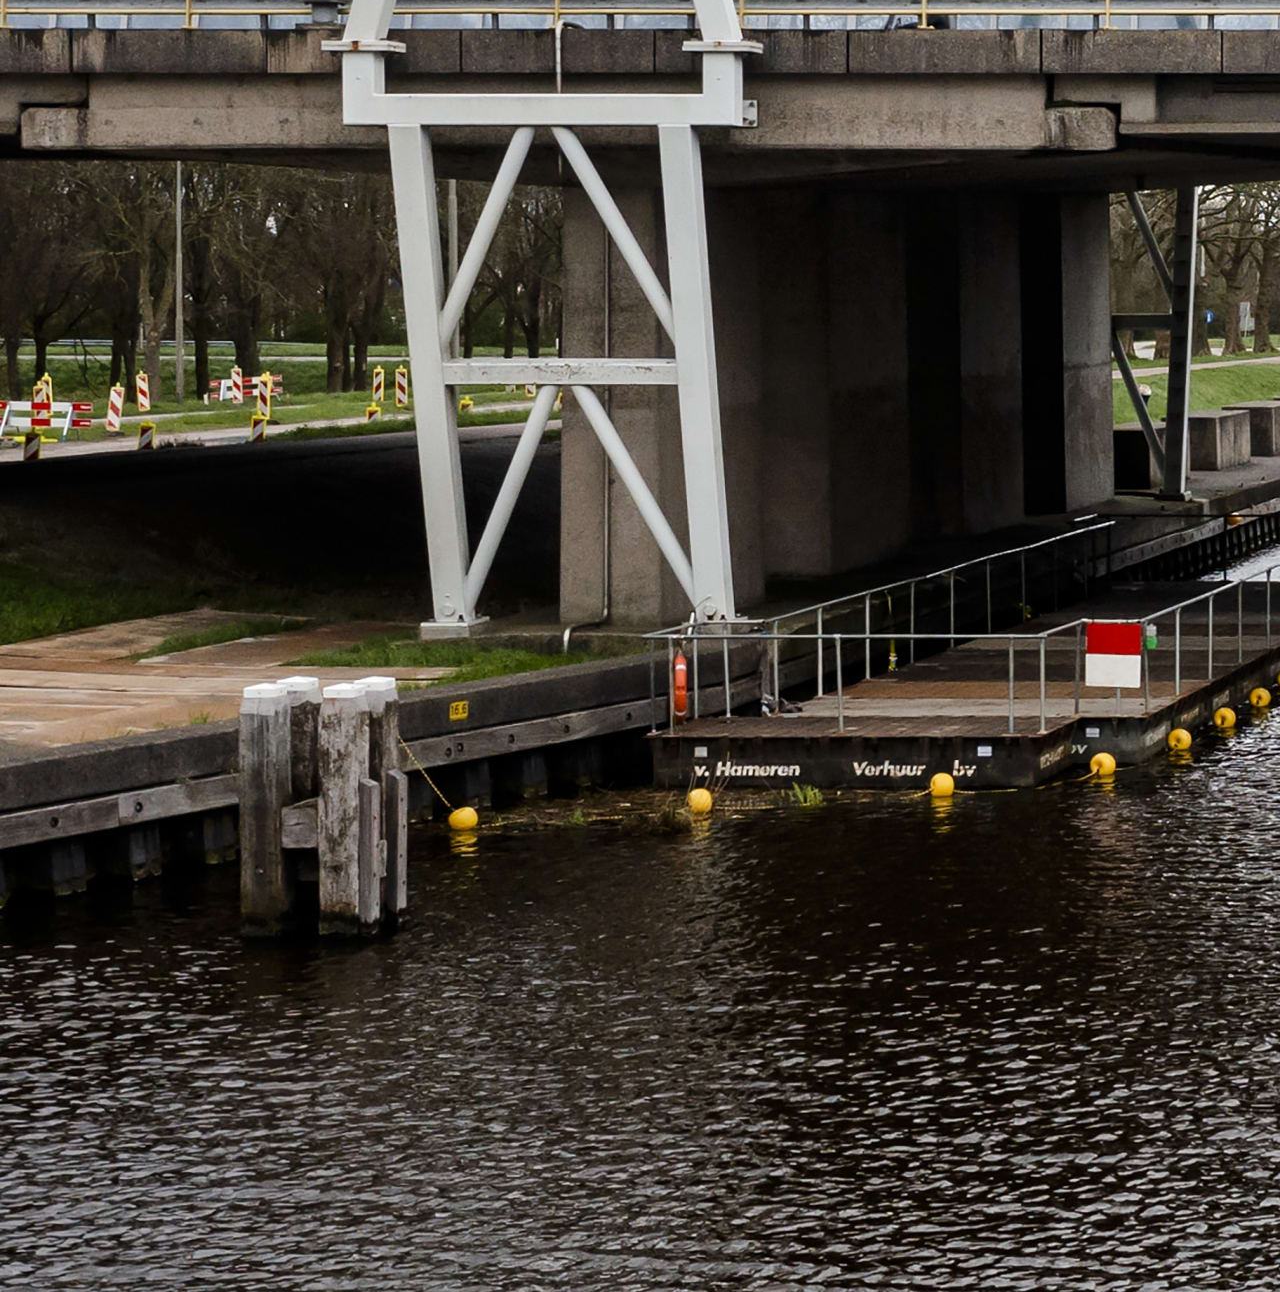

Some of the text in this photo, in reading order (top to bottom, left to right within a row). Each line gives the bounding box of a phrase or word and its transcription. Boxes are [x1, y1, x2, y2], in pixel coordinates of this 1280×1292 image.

[693, 765, 710, 777] v.
[852, 759, 927, 777] Verhuur
[952, 759, 977, 777] bv
